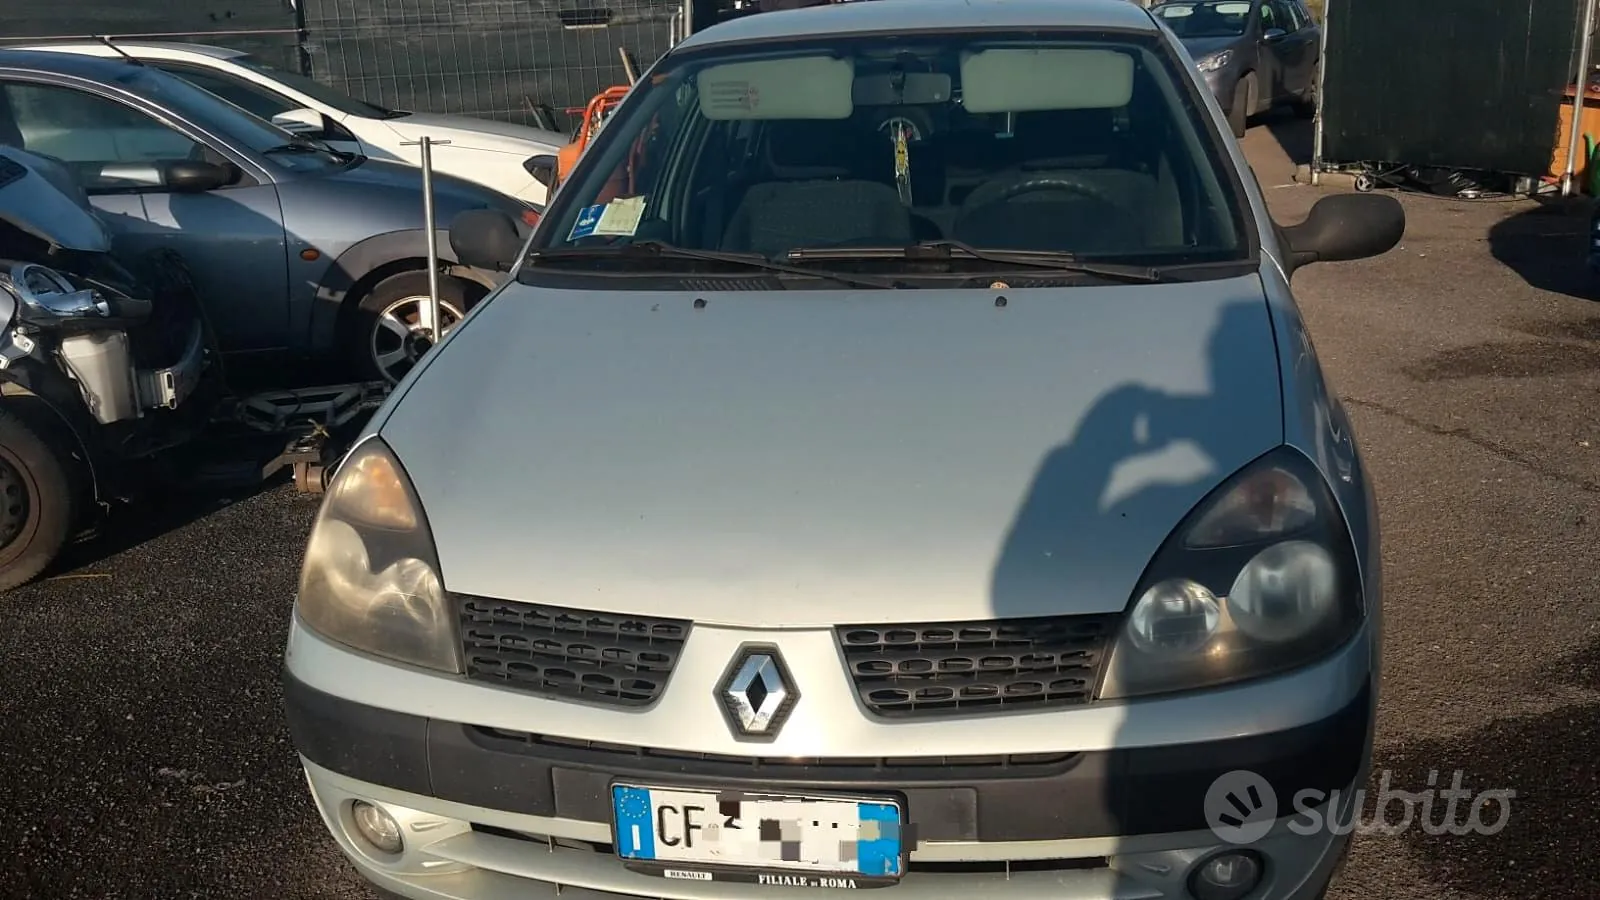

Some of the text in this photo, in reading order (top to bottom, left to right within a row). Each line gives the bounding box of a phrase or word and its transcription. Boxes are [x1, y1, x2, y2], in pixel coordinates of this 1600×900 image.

[631, 824, 641, 850] I
[758, 874, 808, 886] FILIALE
[819, 877, 857, 889] ROMA
